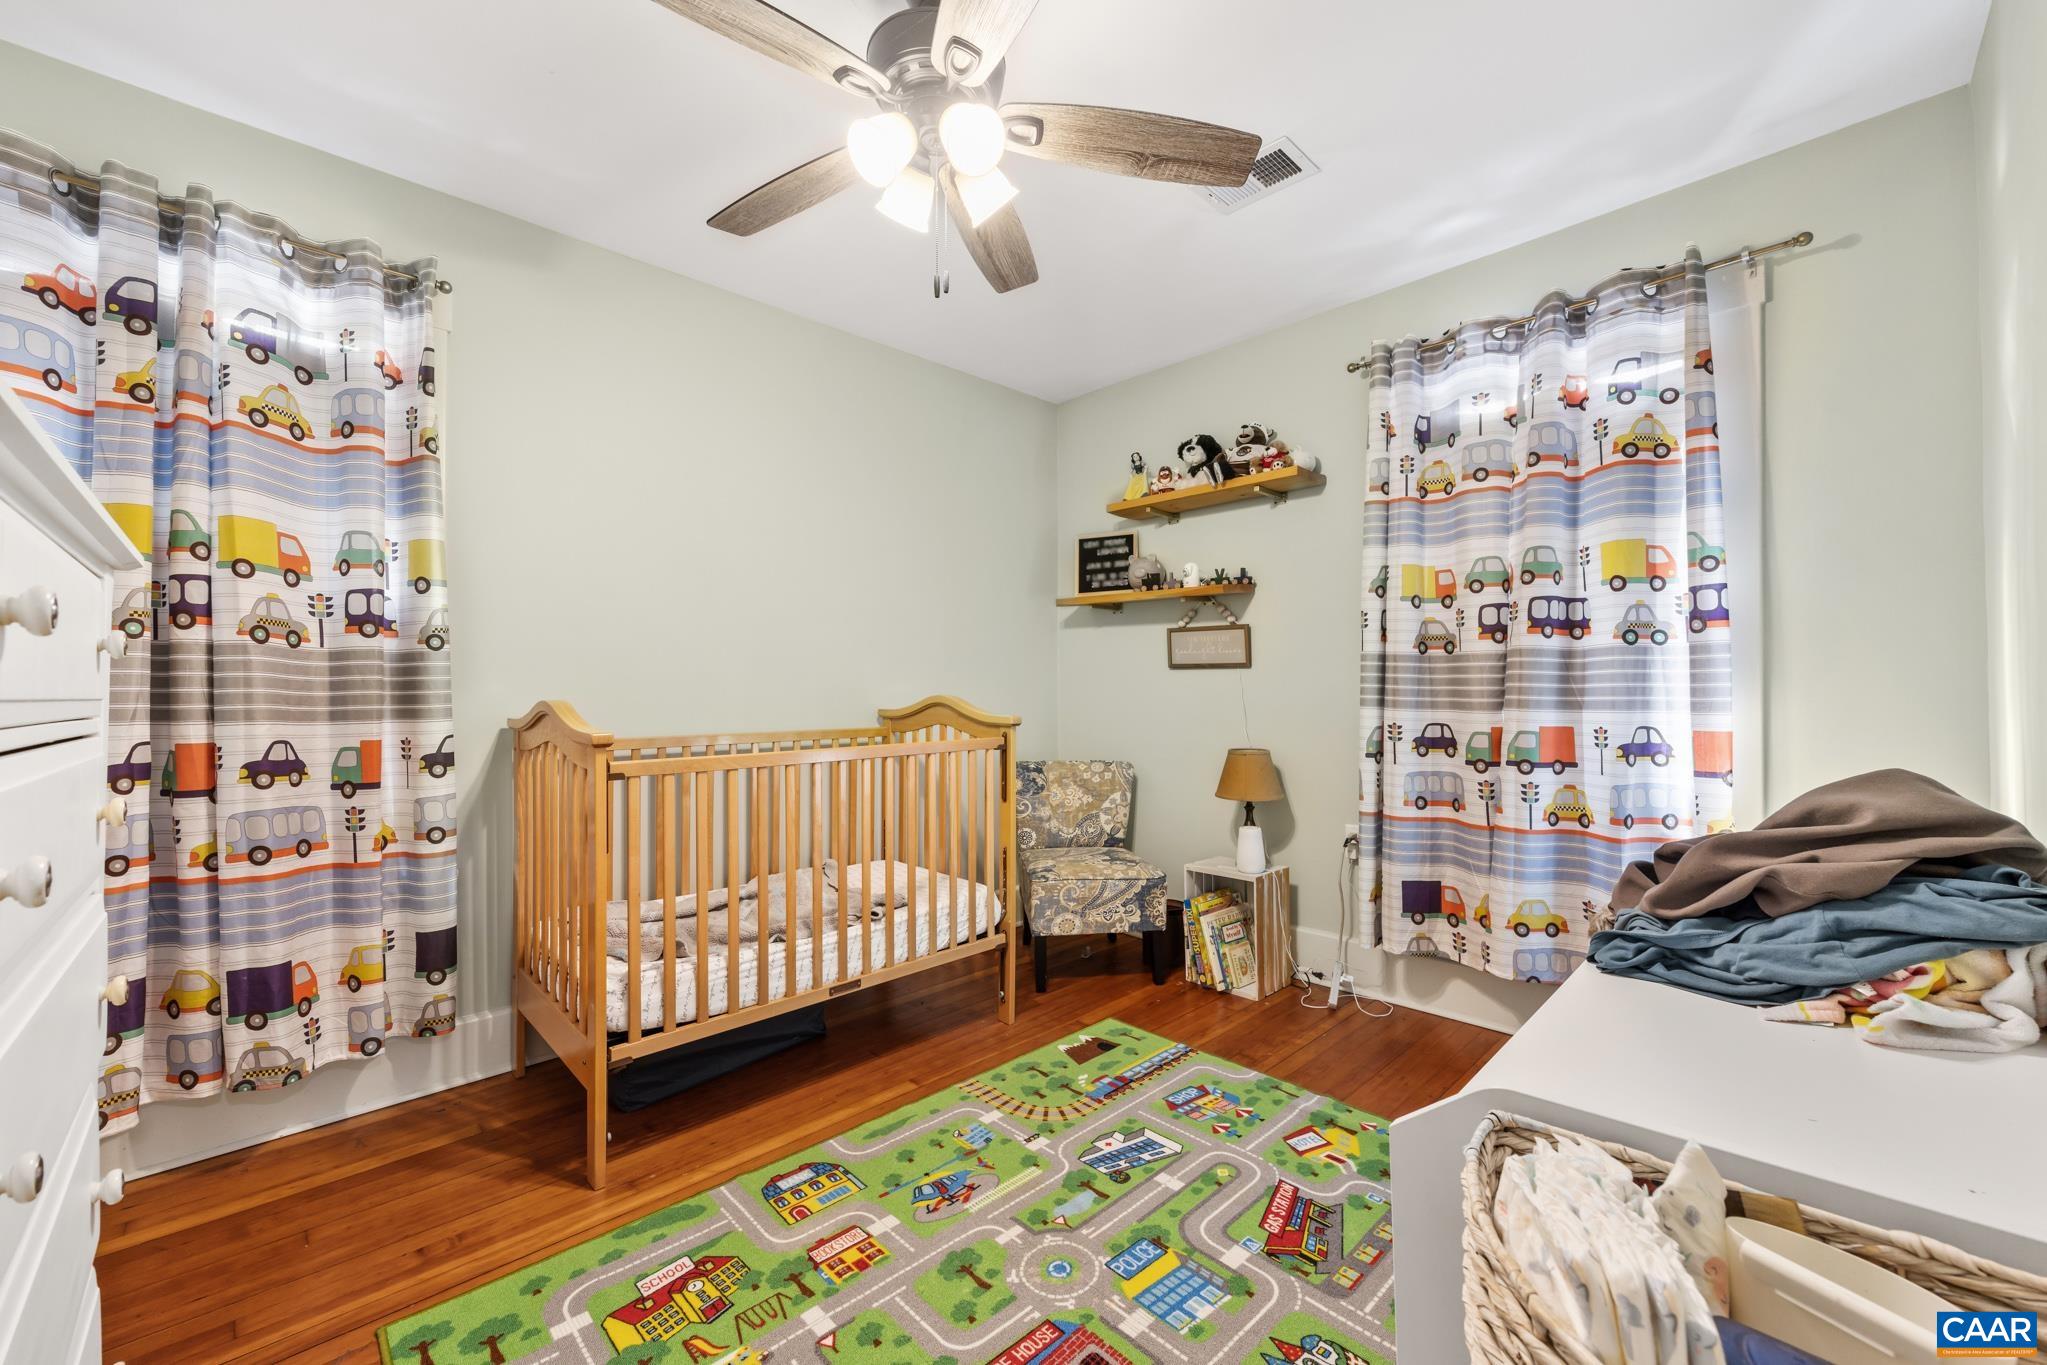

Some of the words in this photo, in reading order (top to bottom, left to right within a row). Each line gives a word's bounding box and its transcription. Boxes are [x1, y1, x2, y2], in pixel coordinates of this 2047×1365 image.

[1190, 925, 1200, 953] SUPER
[1168, 1087, 1199, 1104] SHOP
[1291, 1135, 1321, 1148] HOTEL
[1271, 1182, 1295, 1216] STATION
[1264, 1214, 1284, 1234] GAS
[810, 1228, 864, 1261] BOOKSTORE
[1110, 1240, 1161, 1278] POLICE
[640, 1259, 692, 1293] SCHOOL
[1011, 1325, 1059, 1361] HOUSE
